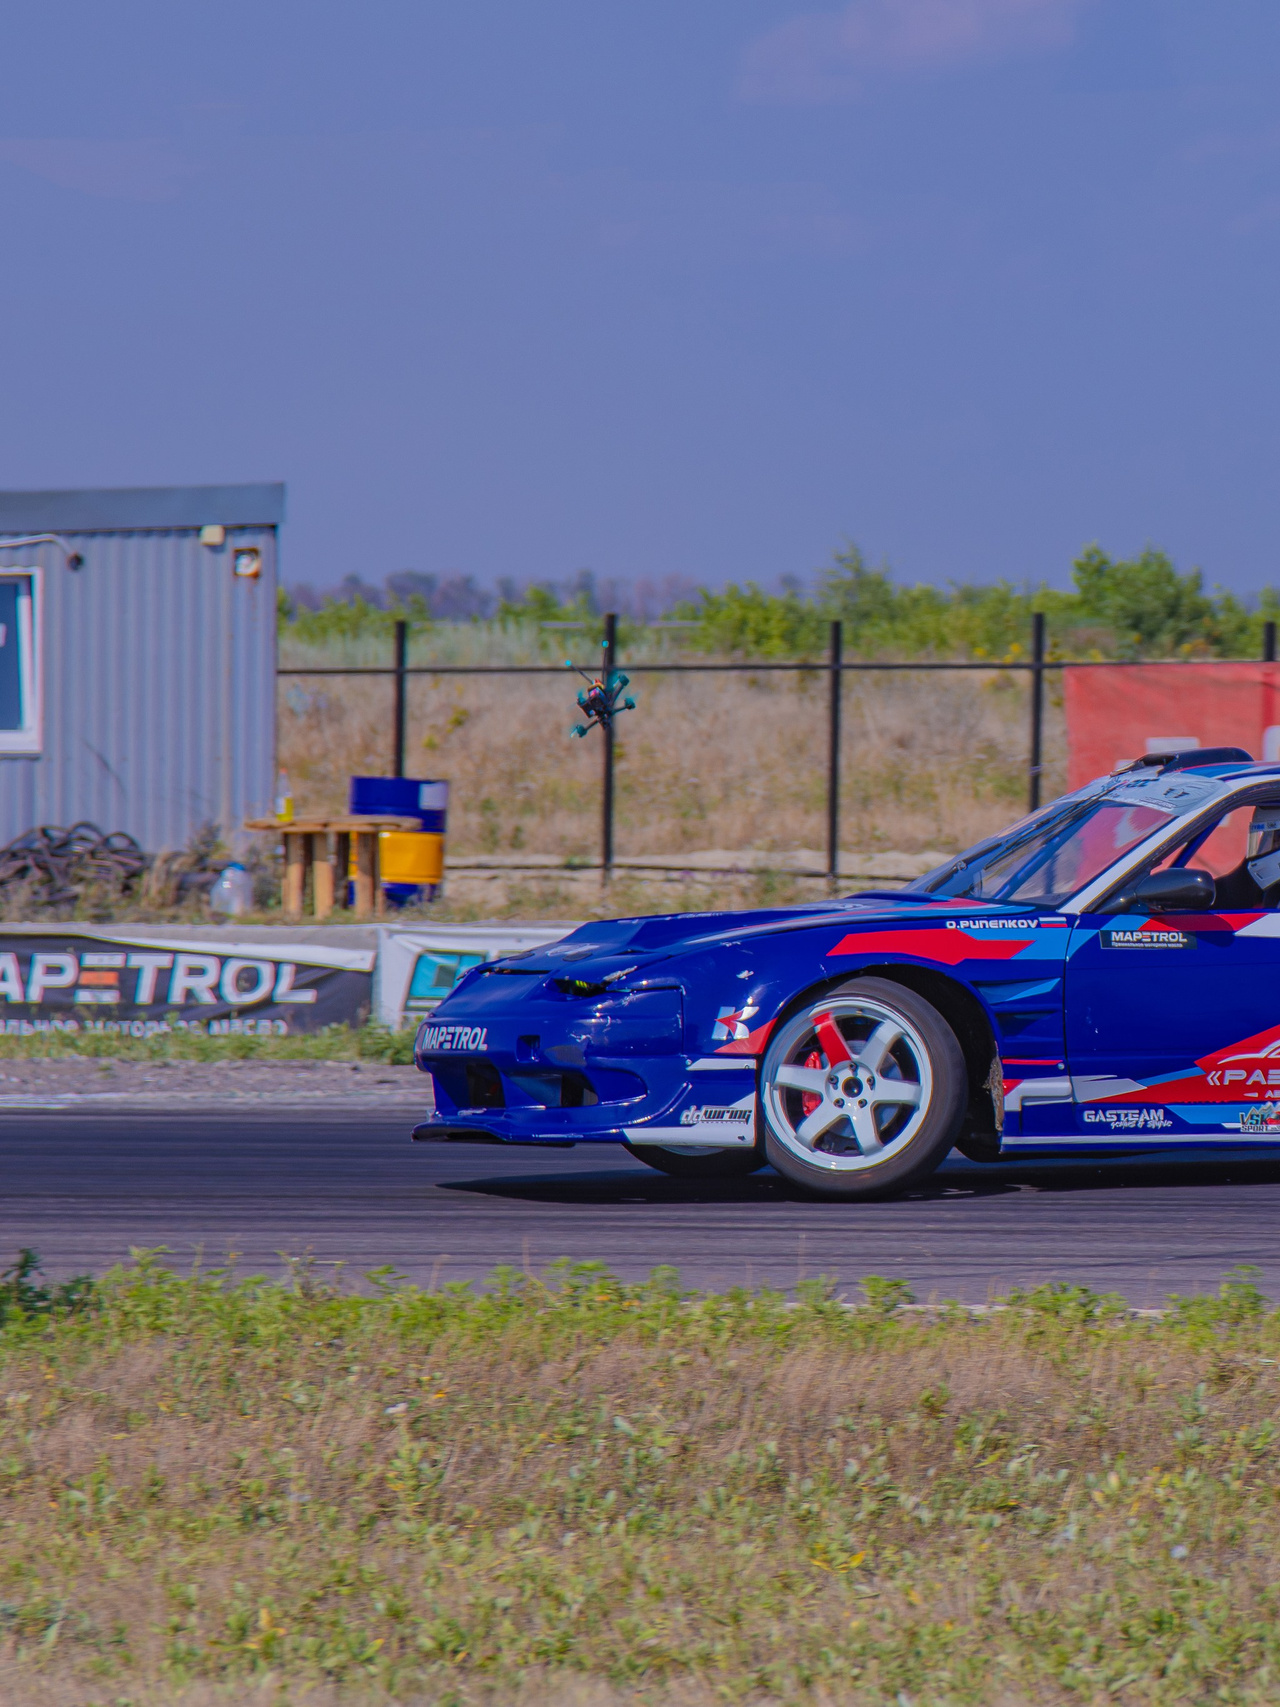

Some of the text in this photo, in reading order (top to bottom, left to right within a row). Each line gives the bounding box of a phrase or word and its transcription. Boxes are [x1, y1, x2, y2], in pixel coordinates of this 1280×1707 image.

[1111, 931, 1188, 942] MAPETROL
[422, 1026, 488, 1051] MAPETROL
[1083, 1108, 1164, 1122] GASTEAM
